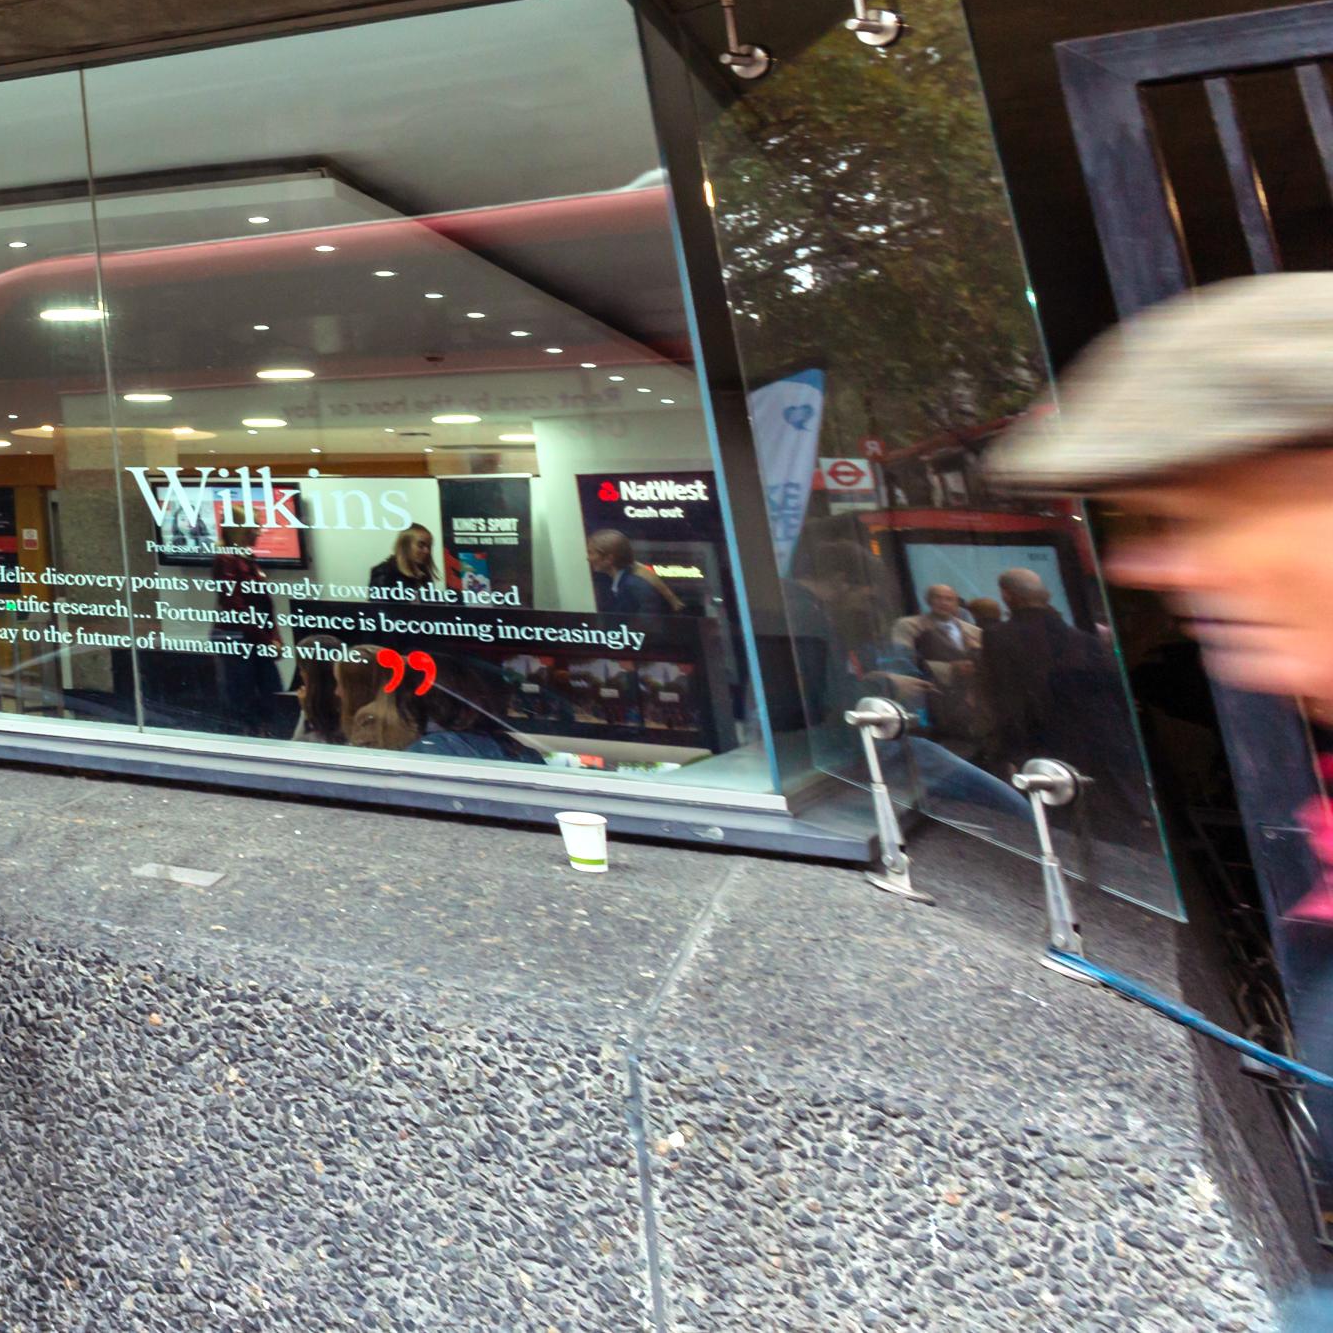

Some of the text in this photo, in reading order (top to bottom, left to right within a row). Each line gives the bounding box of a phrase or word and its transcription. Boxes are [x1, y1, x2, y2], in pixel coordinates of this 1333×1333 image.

[125, 466, 414, 532] Wilkins
[619, 479, 710, 502] NatWest
[623, 505, 684, 519] Cash out
[146, 540, 253, 555] Professor Maurice
[40, 567, 126, 591] discovery
[131, 572, 189, 592] points
[192, 578, 237, 596] very
[240, 577, 323, 600] strongly
[328, 581, 417, 601] towards
[419, 582, 458, 604] the
[462, 585, 521, 606] need
[22, 627, 41, 642] to
[43, 625, 73, 644] the
[76, 627, 132, 648] future
[136, 631, 157, 650] of
[159, 631, 254, 659] humanity
[256, 643, 278, 658] as
[281, 644, 294, 659] a
[295, 641, 369, 664] whole.
[53, 599, 130, 618] research
[155, 601, 274, 629] Fortunately,
[276, 608, 355, 630] science
[358, 611, 377, 632] is
[378, 612, 494, 642] becoming
[496, 618, 646, 651] increasingly
